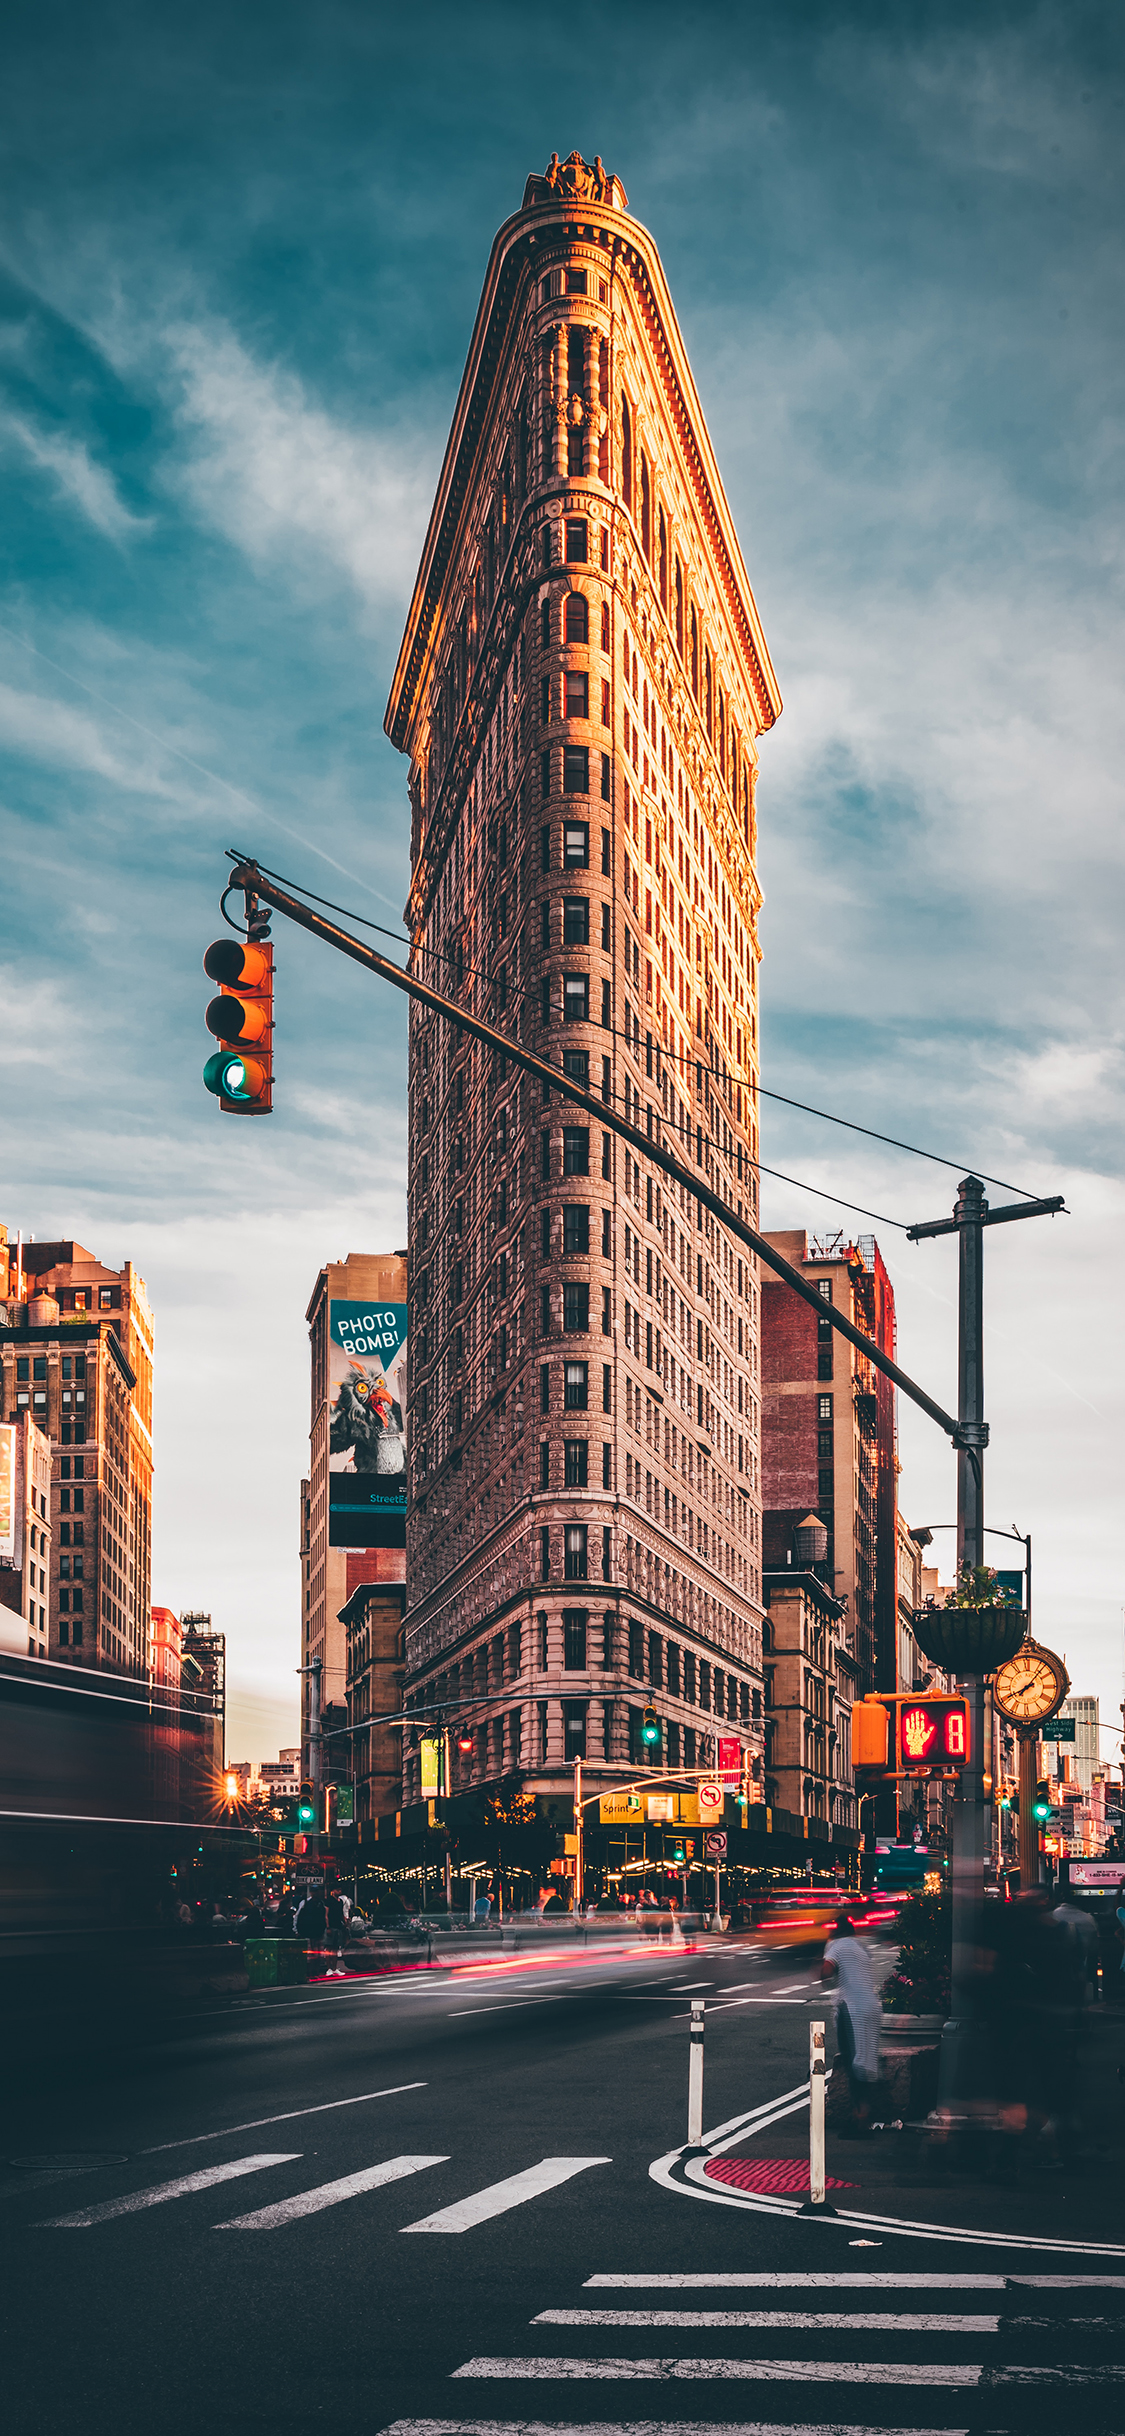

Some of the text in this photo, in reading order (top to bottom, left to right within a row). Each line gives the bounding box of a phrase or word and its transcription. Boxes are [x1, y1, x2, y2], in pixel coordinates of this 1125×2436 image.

[338, 1312, 396, 1337] PHOTO
[343, 1331, 400, 1356] BOMB!
[604, 1804, 629, 1814] Sprint
